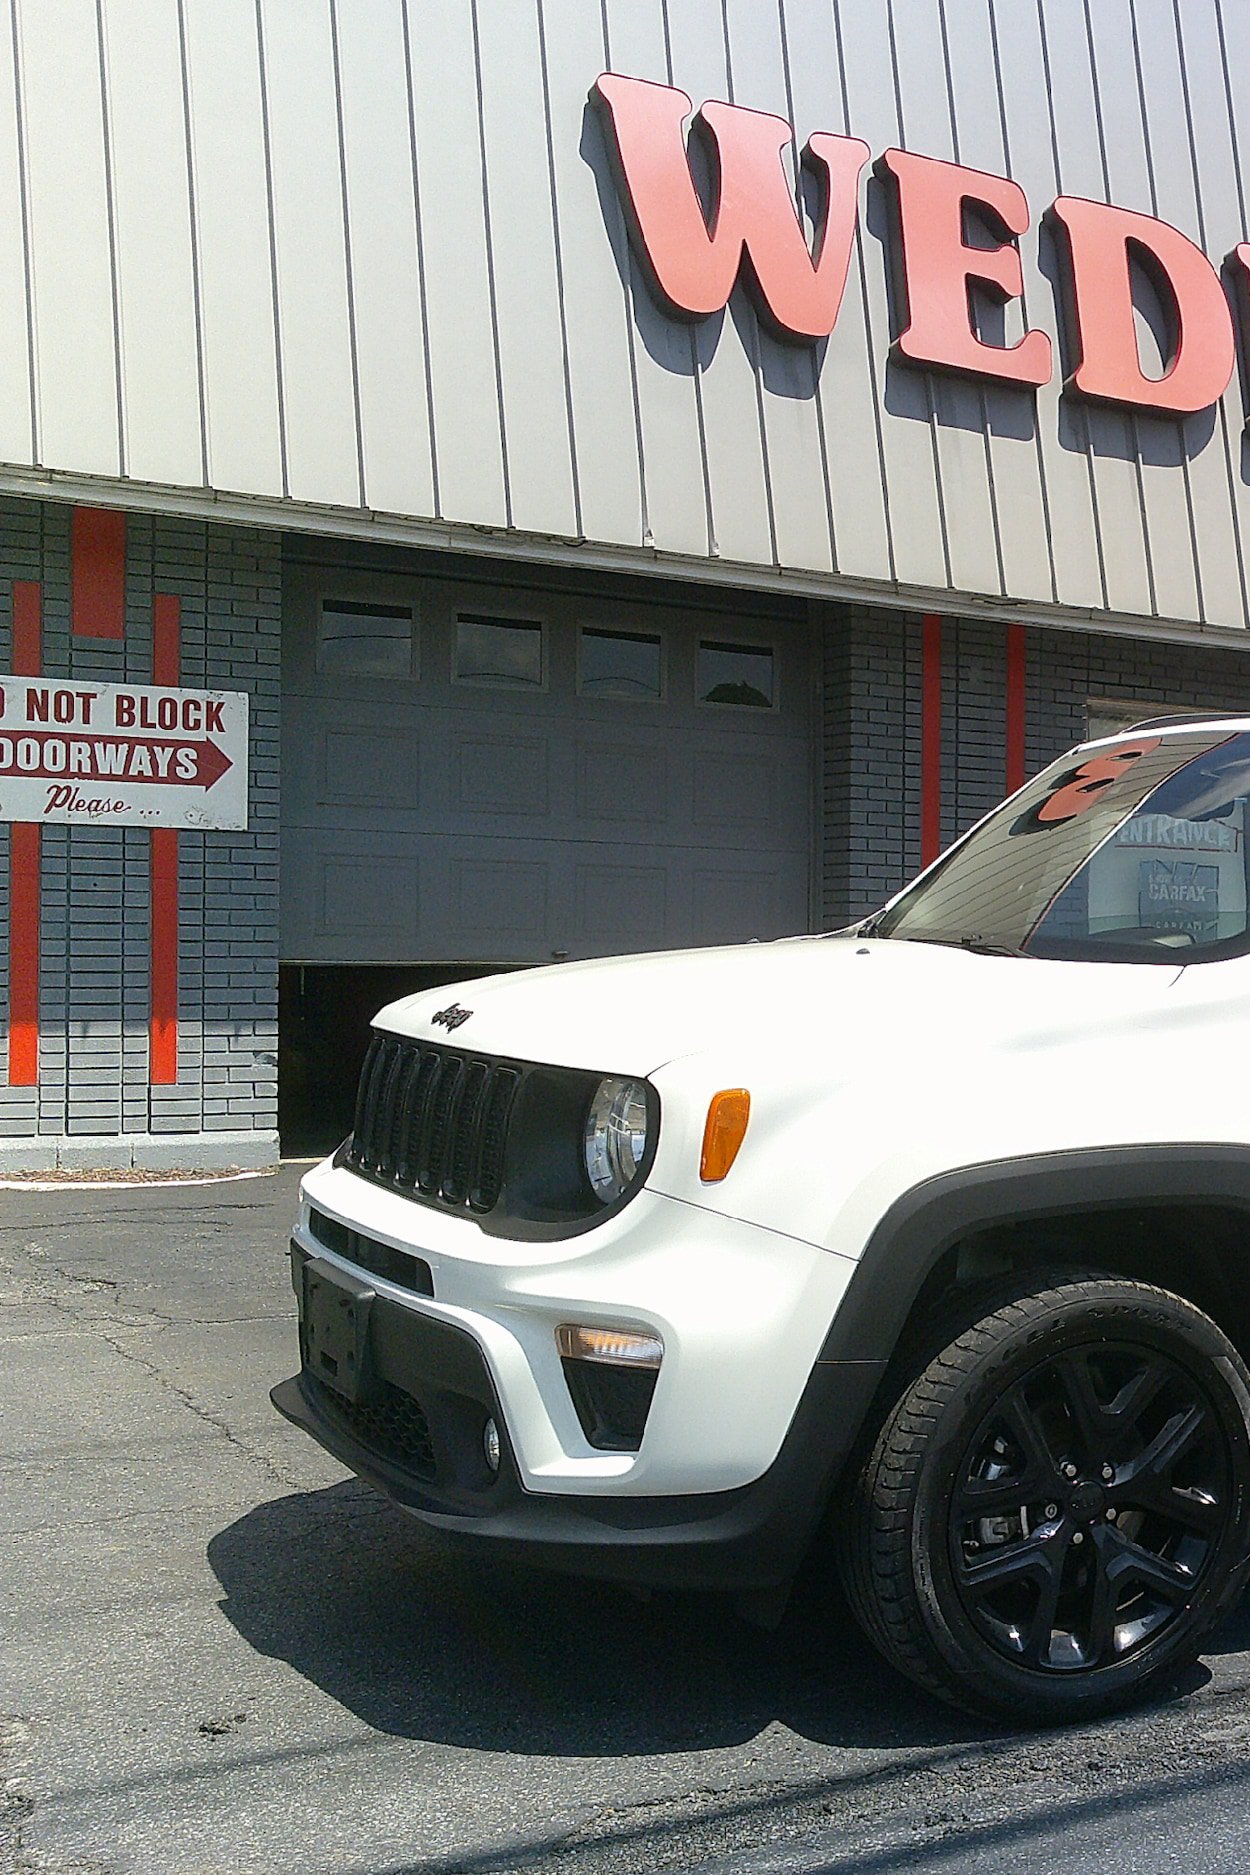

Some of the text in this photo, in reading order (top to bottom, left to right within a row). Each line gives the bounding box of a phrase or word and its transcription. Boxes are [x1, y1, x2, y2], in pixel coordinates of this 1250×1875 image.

[26, 688, 98, 725] NOT
[116, 694, 226, 733] BLOCK
[0, 737, 198, 779] DOORWAYS
[44, 784, 131, 814] Please
[1148, 883, 1206, 902] CARFAX
